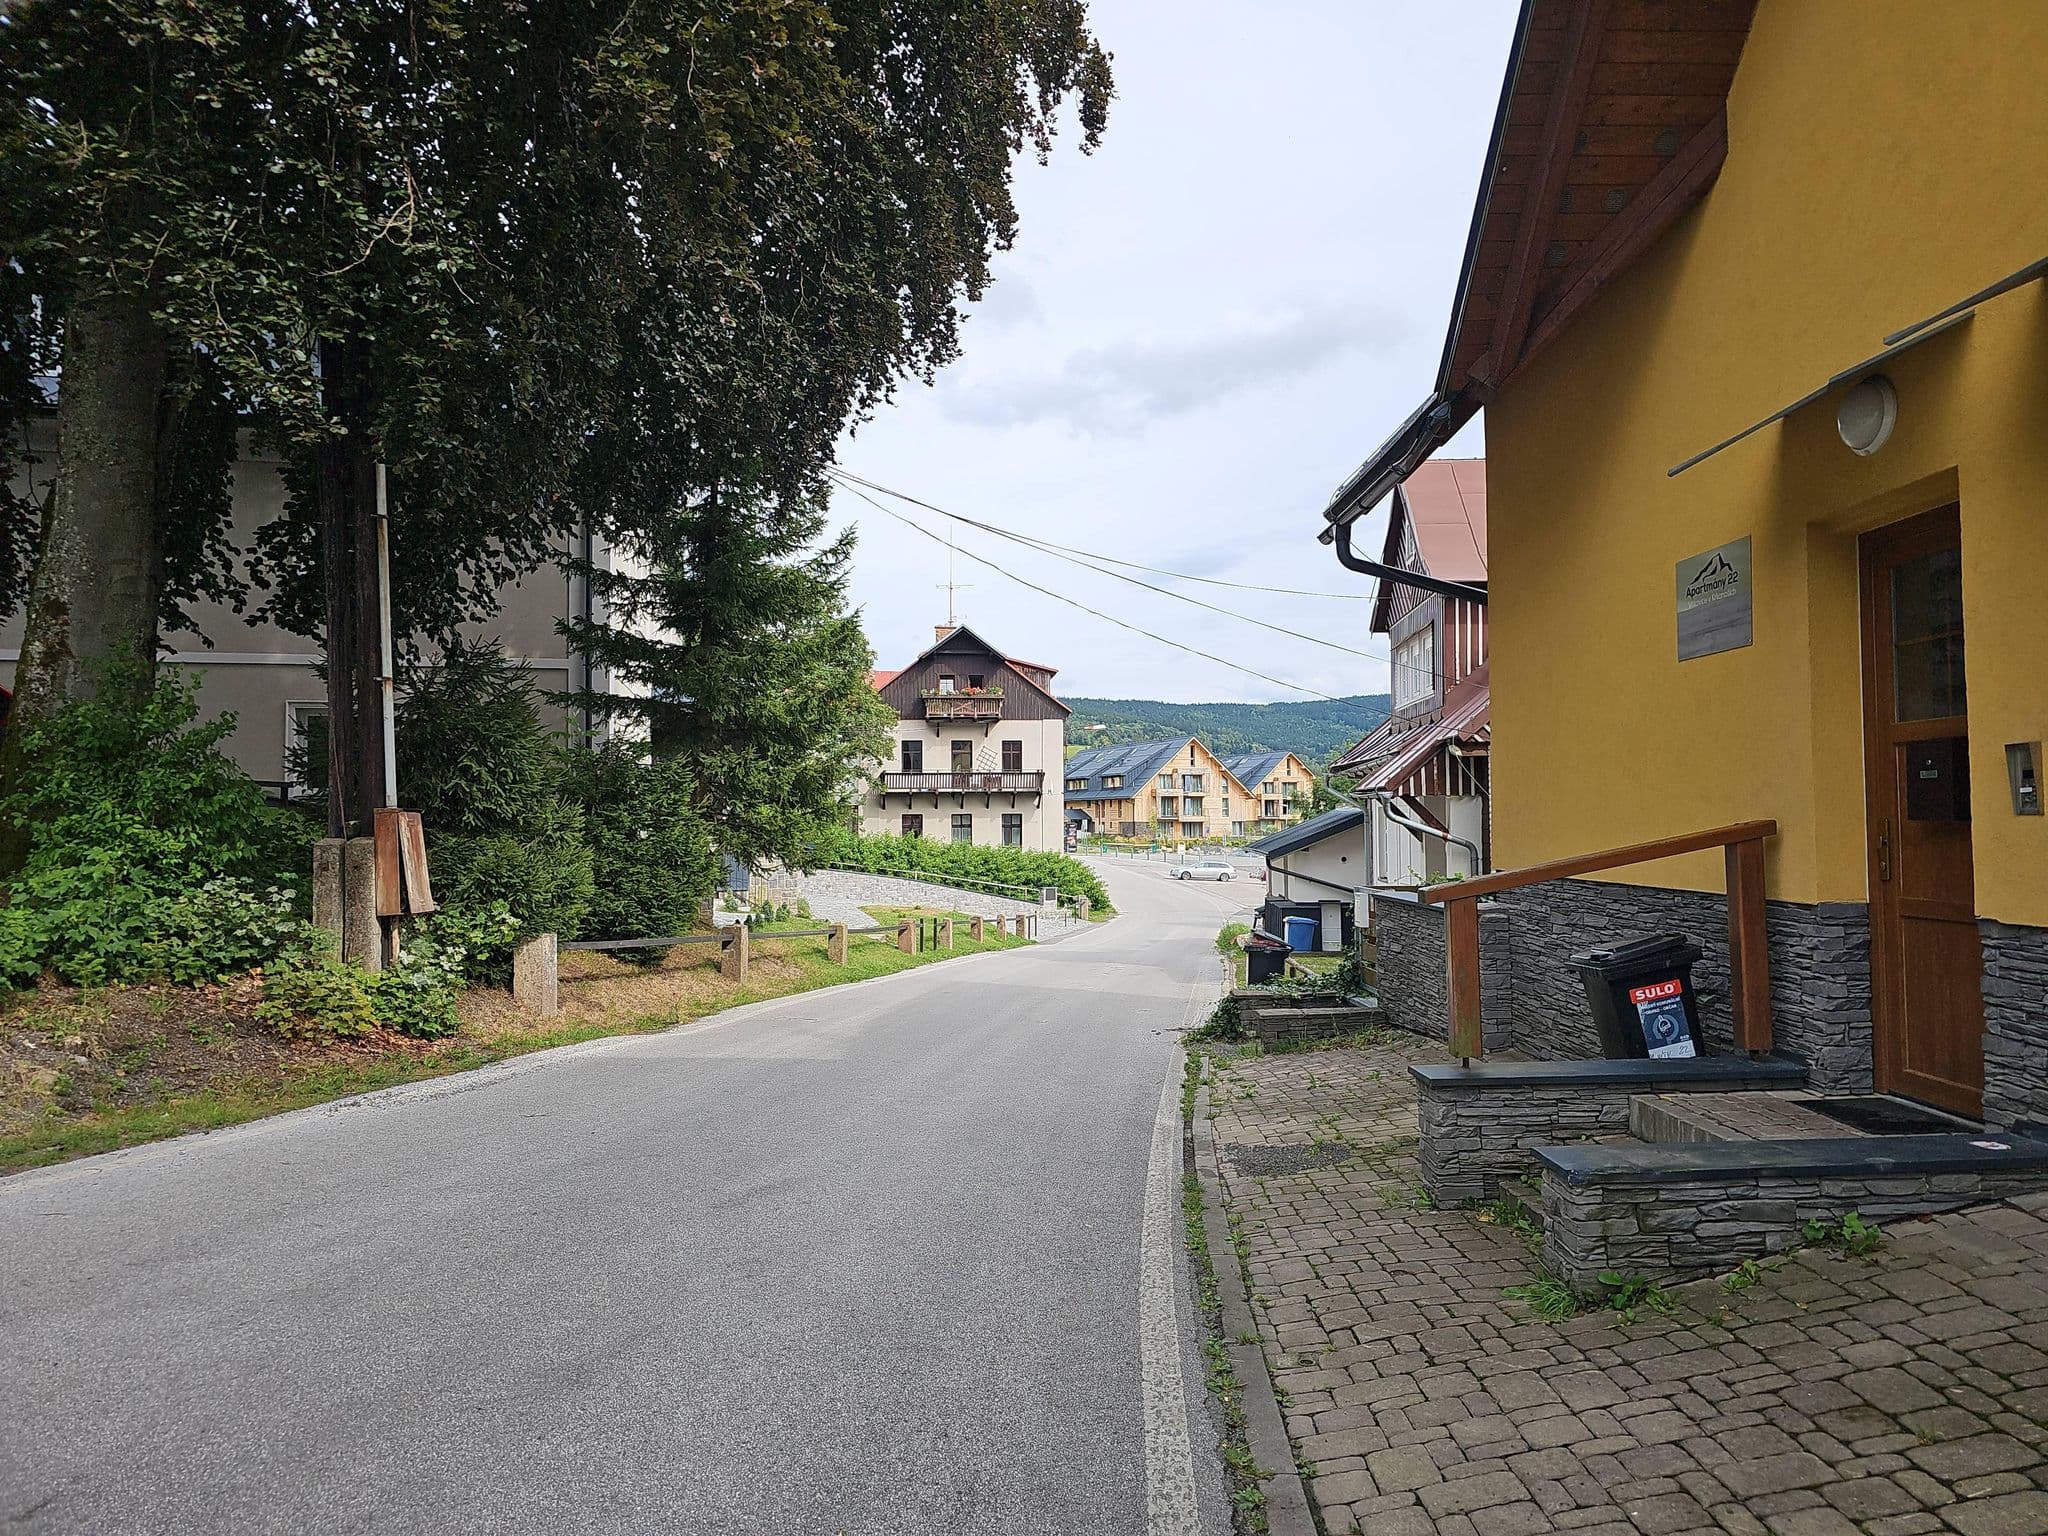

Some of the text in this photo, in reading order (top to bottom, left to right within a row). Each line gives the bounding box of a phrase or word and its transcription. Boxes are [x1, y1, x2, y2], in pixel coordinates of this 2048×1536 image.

[1686, 578, 1726, 598] Apartmány
[1727, 571, 1738, 585] 22
[1635, 984, 1675, 1000] SULO
